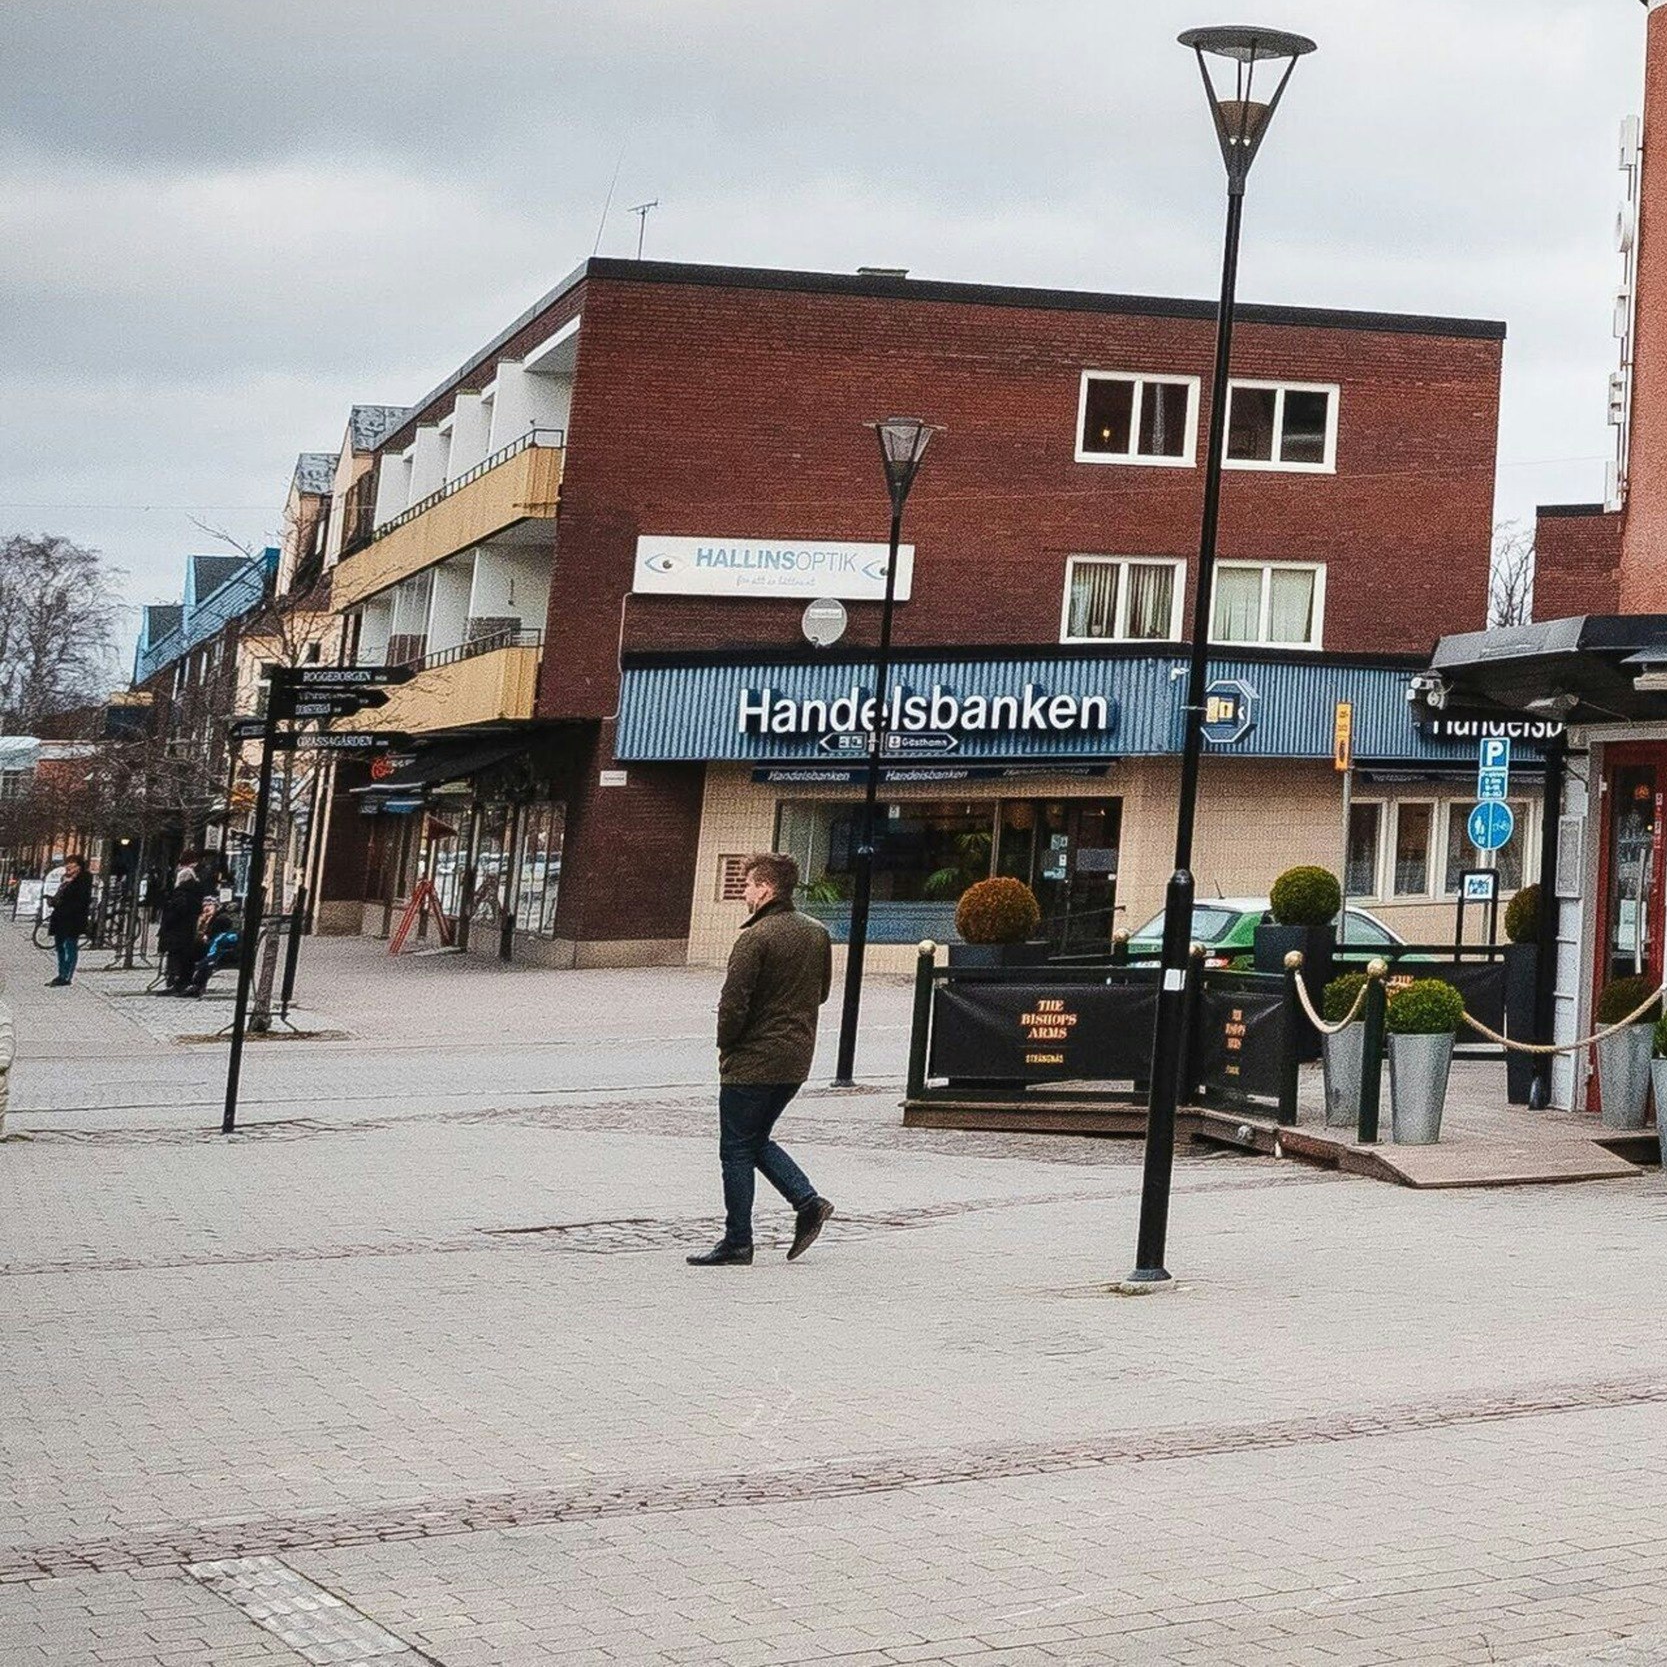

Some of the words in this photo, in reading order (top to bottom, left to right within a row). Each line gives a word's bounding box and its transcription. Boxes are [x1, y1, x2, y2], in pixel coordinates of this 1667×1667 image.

[738, 683, 1108, 734] Handelsbanken
[1486, 740, 1504, 766] P
[1036, 1000, 1065, 1012] THE
[1020, 1013, 1078, 1026] BISHOPS
[1027, 1027, 1068, 1040] ARMS
